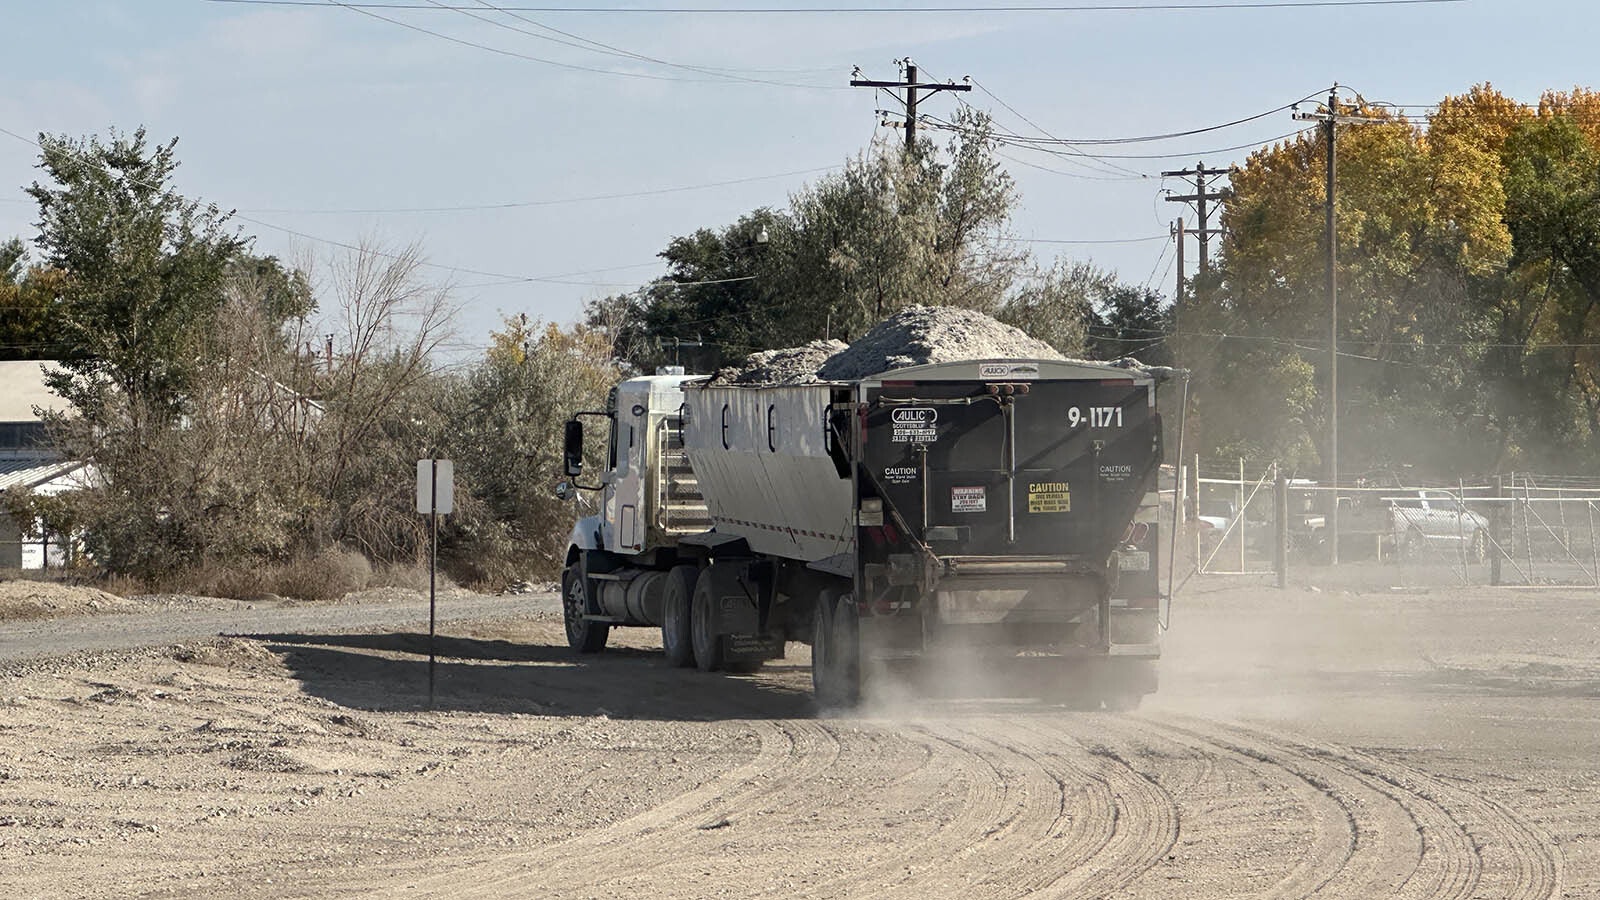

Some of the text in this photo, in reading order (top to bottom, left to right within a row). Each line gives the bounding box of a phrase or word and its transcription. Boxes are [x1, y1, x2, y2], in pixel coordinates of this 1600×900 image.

[896, 410, 932, 421] AULIC
[1068, 406, 1123, 428] 9-1171
[884, 467, 917, 475] CAUTION
[1099, 465, 1131, 473] CAUTION
[1029, 482, 1069, 493] CAUTION
